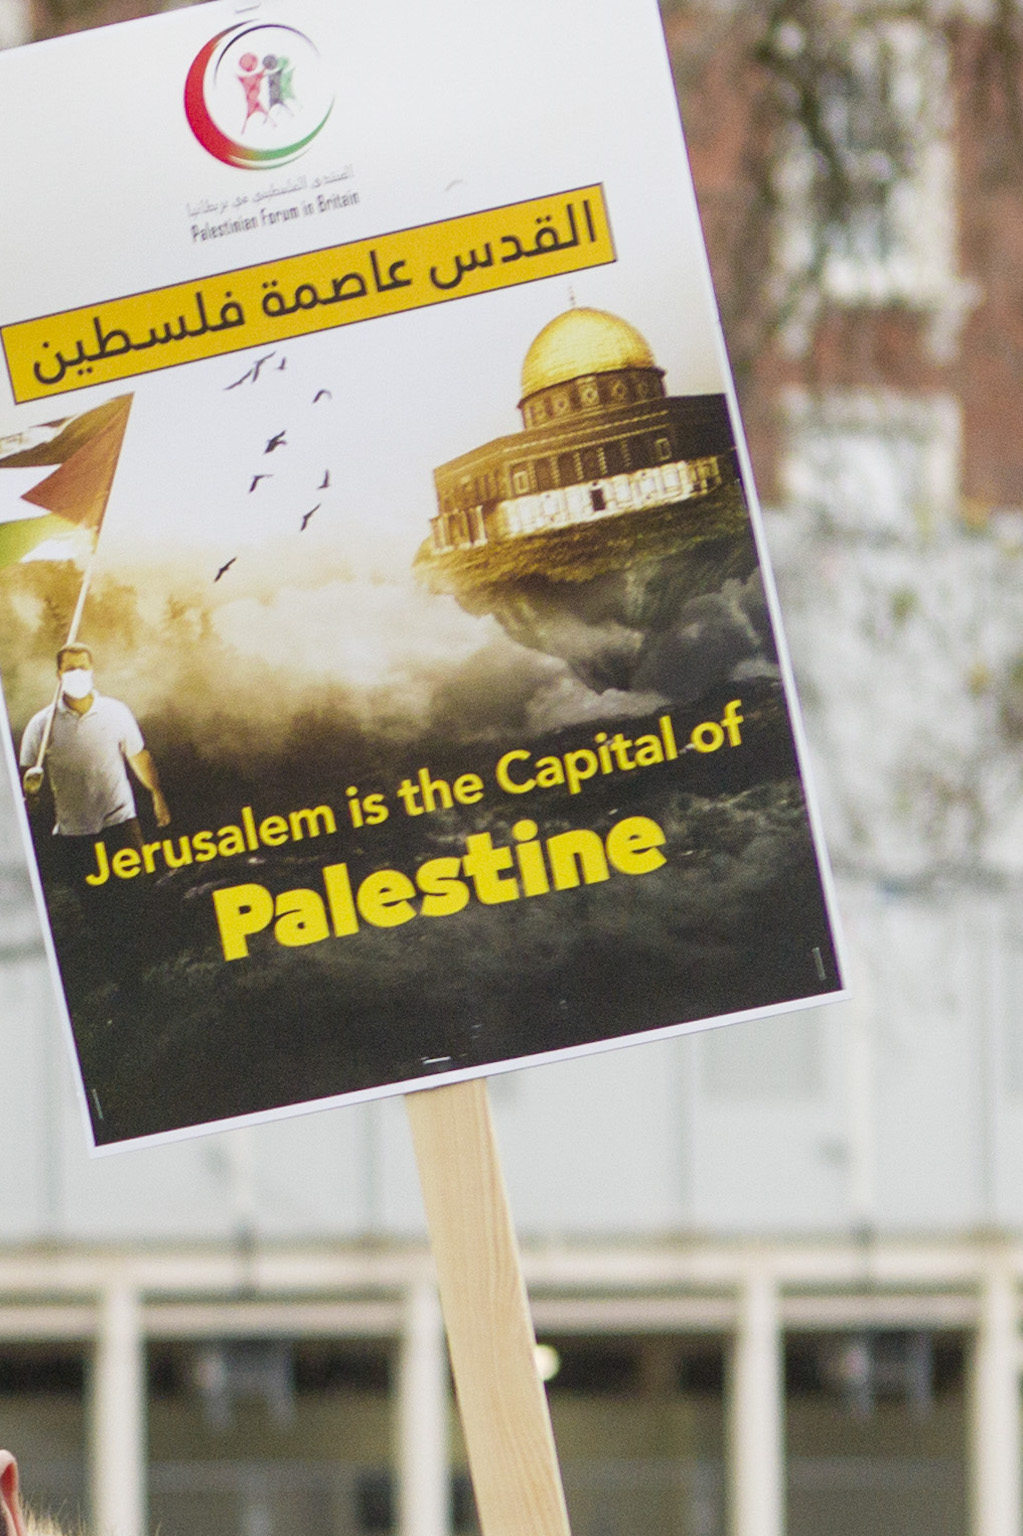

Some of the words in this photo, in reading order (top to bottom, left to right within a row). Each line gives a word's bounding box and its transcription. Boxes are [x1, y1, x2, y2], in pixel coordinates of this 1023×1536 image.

[190, 214, 259, 244] Palestinian
[259, 204, 300, 226] Forum
[301, 199, 315, 217] in
[316, 188, 361, 213] Britain
[428, 198, 598, 291] القدس
[260, 249, 413, 318] عاصمة
[32, 291, 246, 385] فلسطين
[85, 804, 337, 887] Jerusalem
[345, 785, 390, 829] is
[397, 766, 484, 817] the
[495, 715, 678, 797] Capital
[691, 699, 745, 753] of
[212, 814, 669, 962] Palestine
